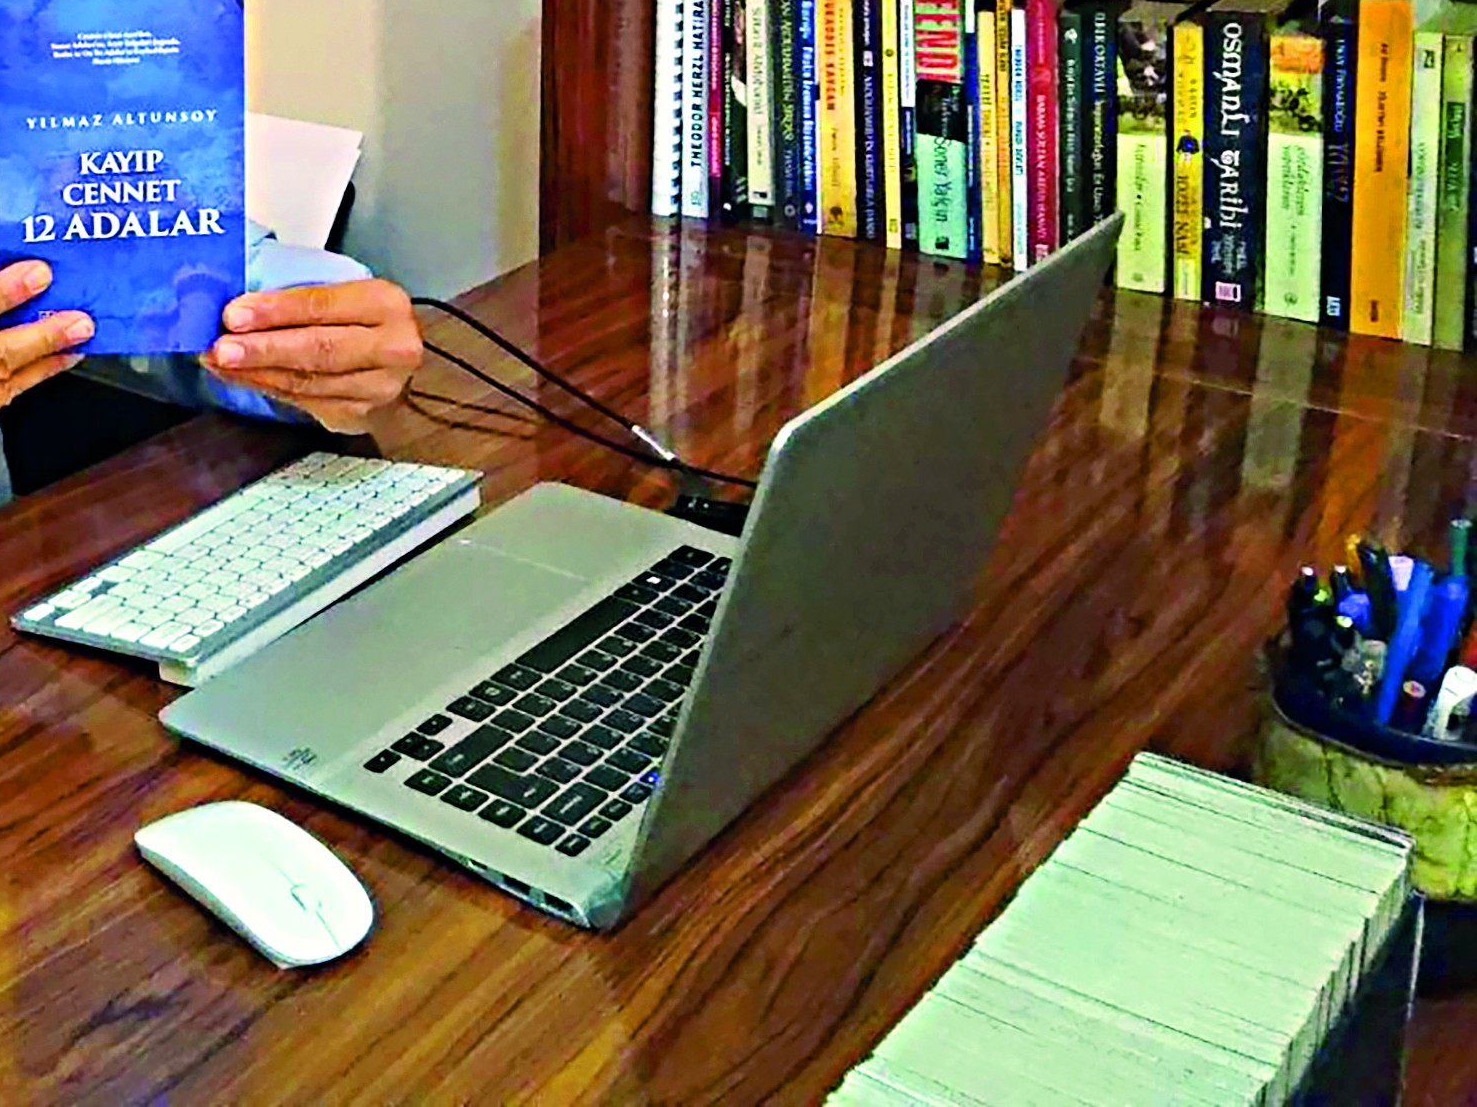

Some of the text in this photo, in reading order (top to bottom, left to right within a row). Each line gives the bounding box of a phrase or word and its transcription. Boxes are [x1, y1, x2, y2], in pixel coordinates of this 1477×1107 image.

[692, 54, 704, 99] HERZL
[27, 109, 218, 130] YILMAZ ALTUNSOY
[691, 103, 704, 168] THEODOR
[80, 149, 164, 176] KAYIP
[934, 137, 952, 177] Soner
[62, 179, 181, 207] CENNET
[22, 208, 225, 243] 12 ADALAR
